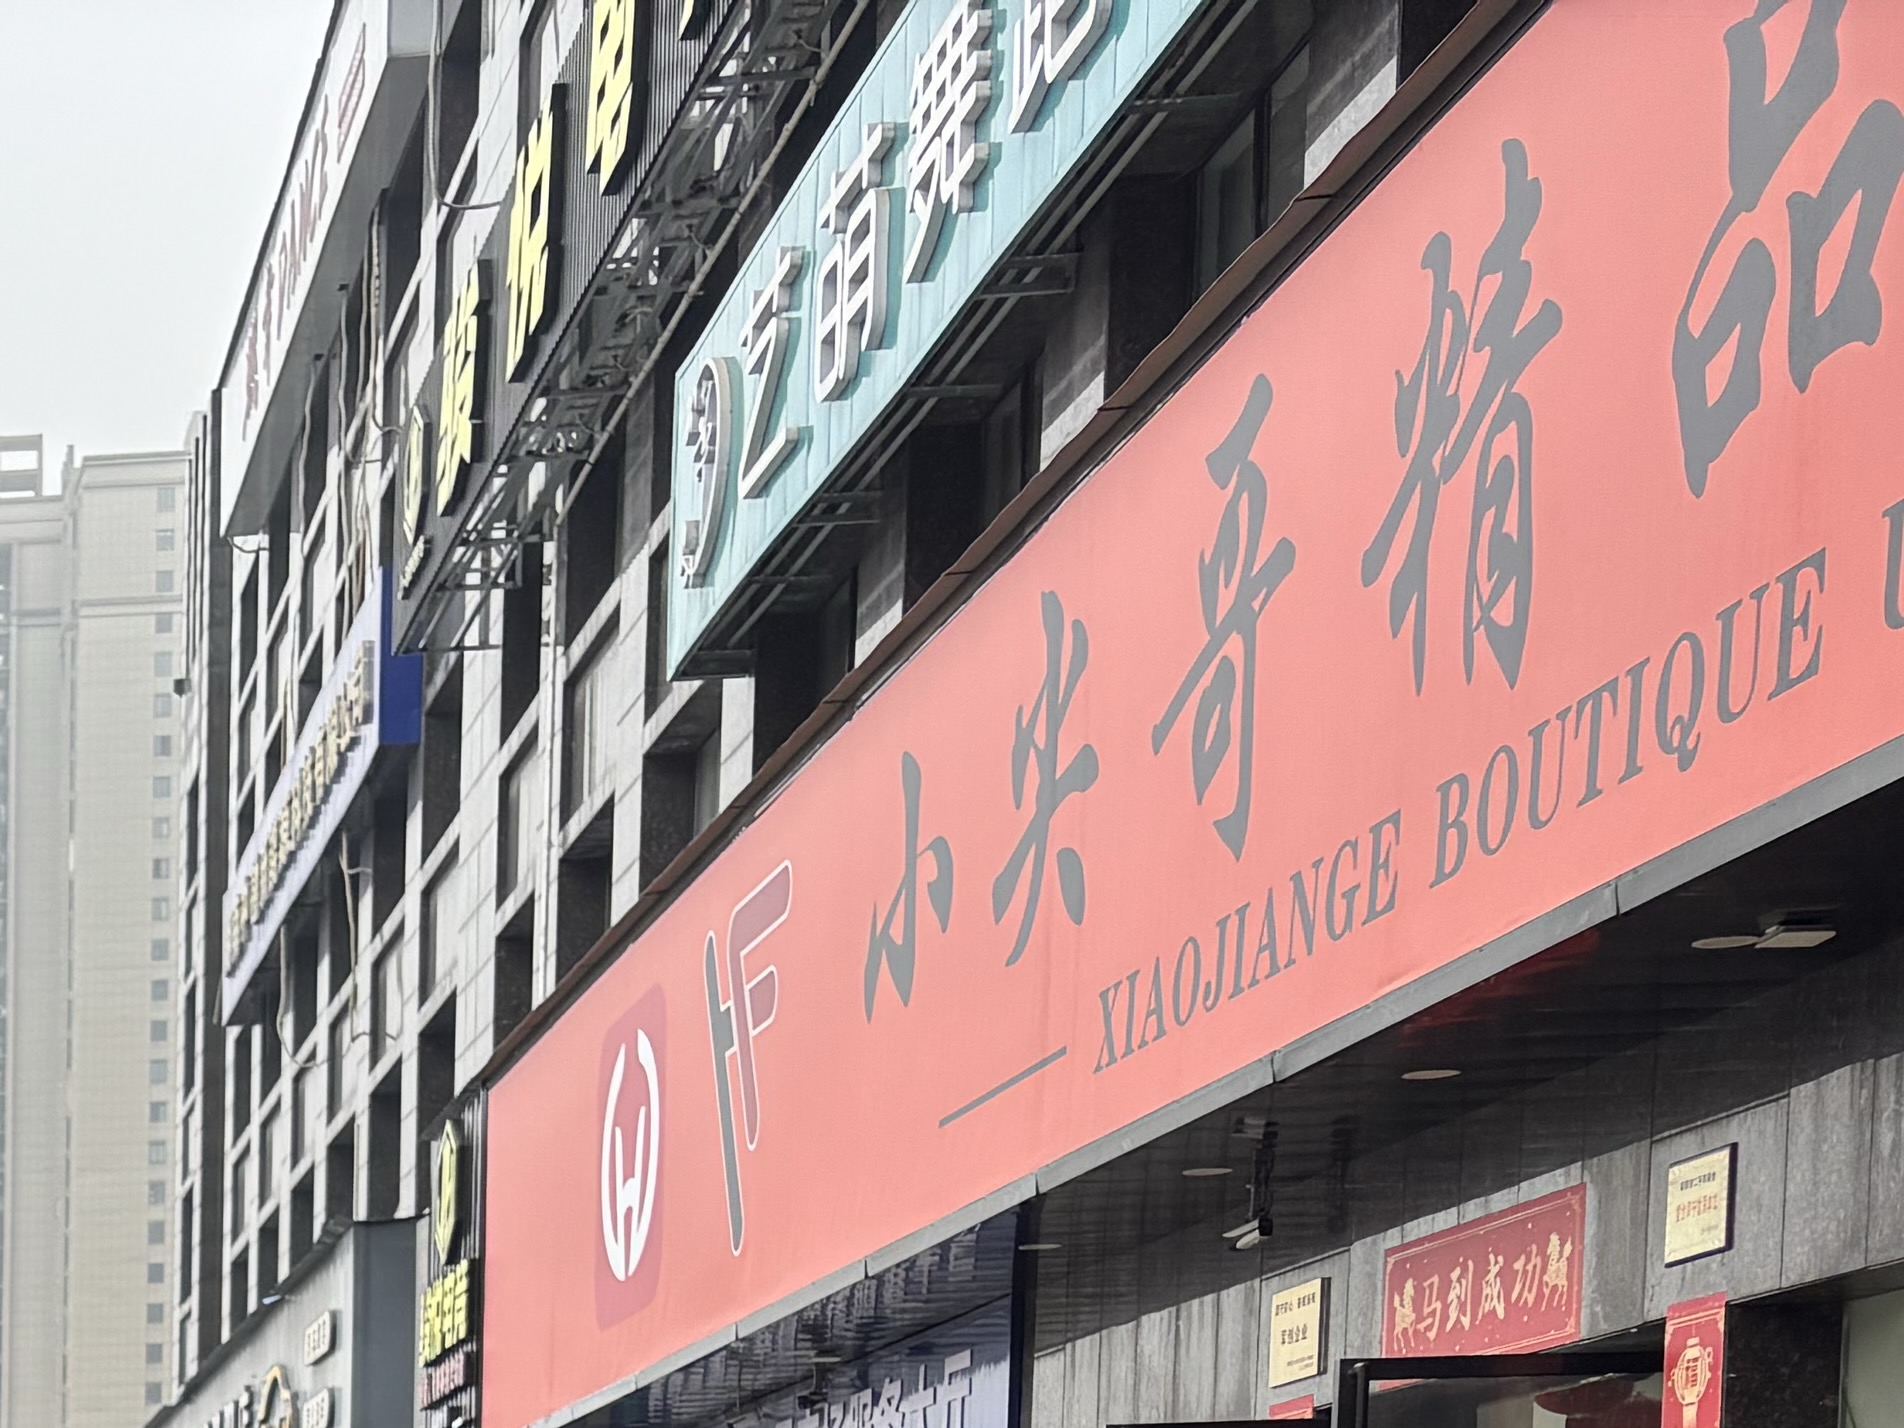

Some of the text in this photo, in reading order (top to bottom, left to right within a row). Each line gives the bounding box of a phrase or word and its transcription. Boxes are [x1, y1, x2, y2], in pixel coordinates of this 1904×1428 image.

[1093, 808, 1401, 1075] XIAOJIANGE
[1429, 546, 1827, 890] BOUTIQUE
[1416, 1243, 1542, 1343] 马到成功
